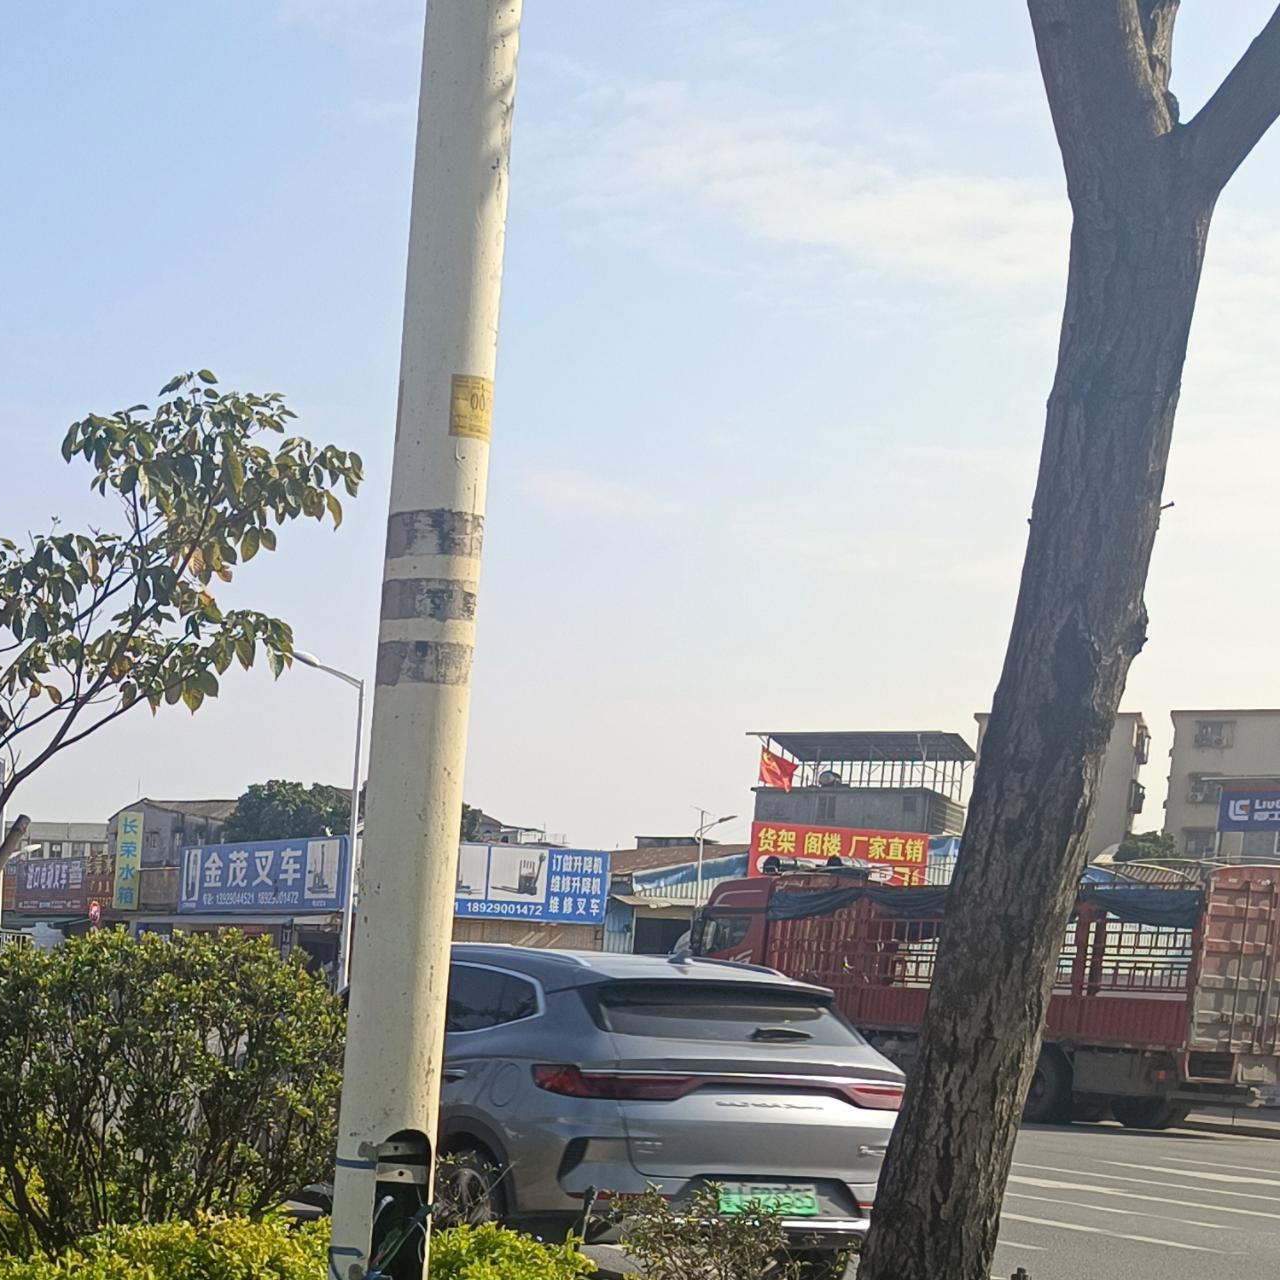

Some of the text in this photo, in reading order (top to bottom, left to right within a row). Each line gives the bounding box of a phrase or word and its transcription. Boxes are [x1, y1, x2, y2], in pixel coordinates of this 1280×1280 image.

[757, 827, 924, 863] 货架 阁楼 厂家直销
[117, 816, 139, 905] 长荣水箱
[204, 848, 302, 888] 金茂叉车
[552, 854, 603, 874] 订做升降机
[550, 876, 601, 895] 维修升降机
[466, 902, 543, 916] 18929001472
[548, 897, 600, 916] 维修叉车
